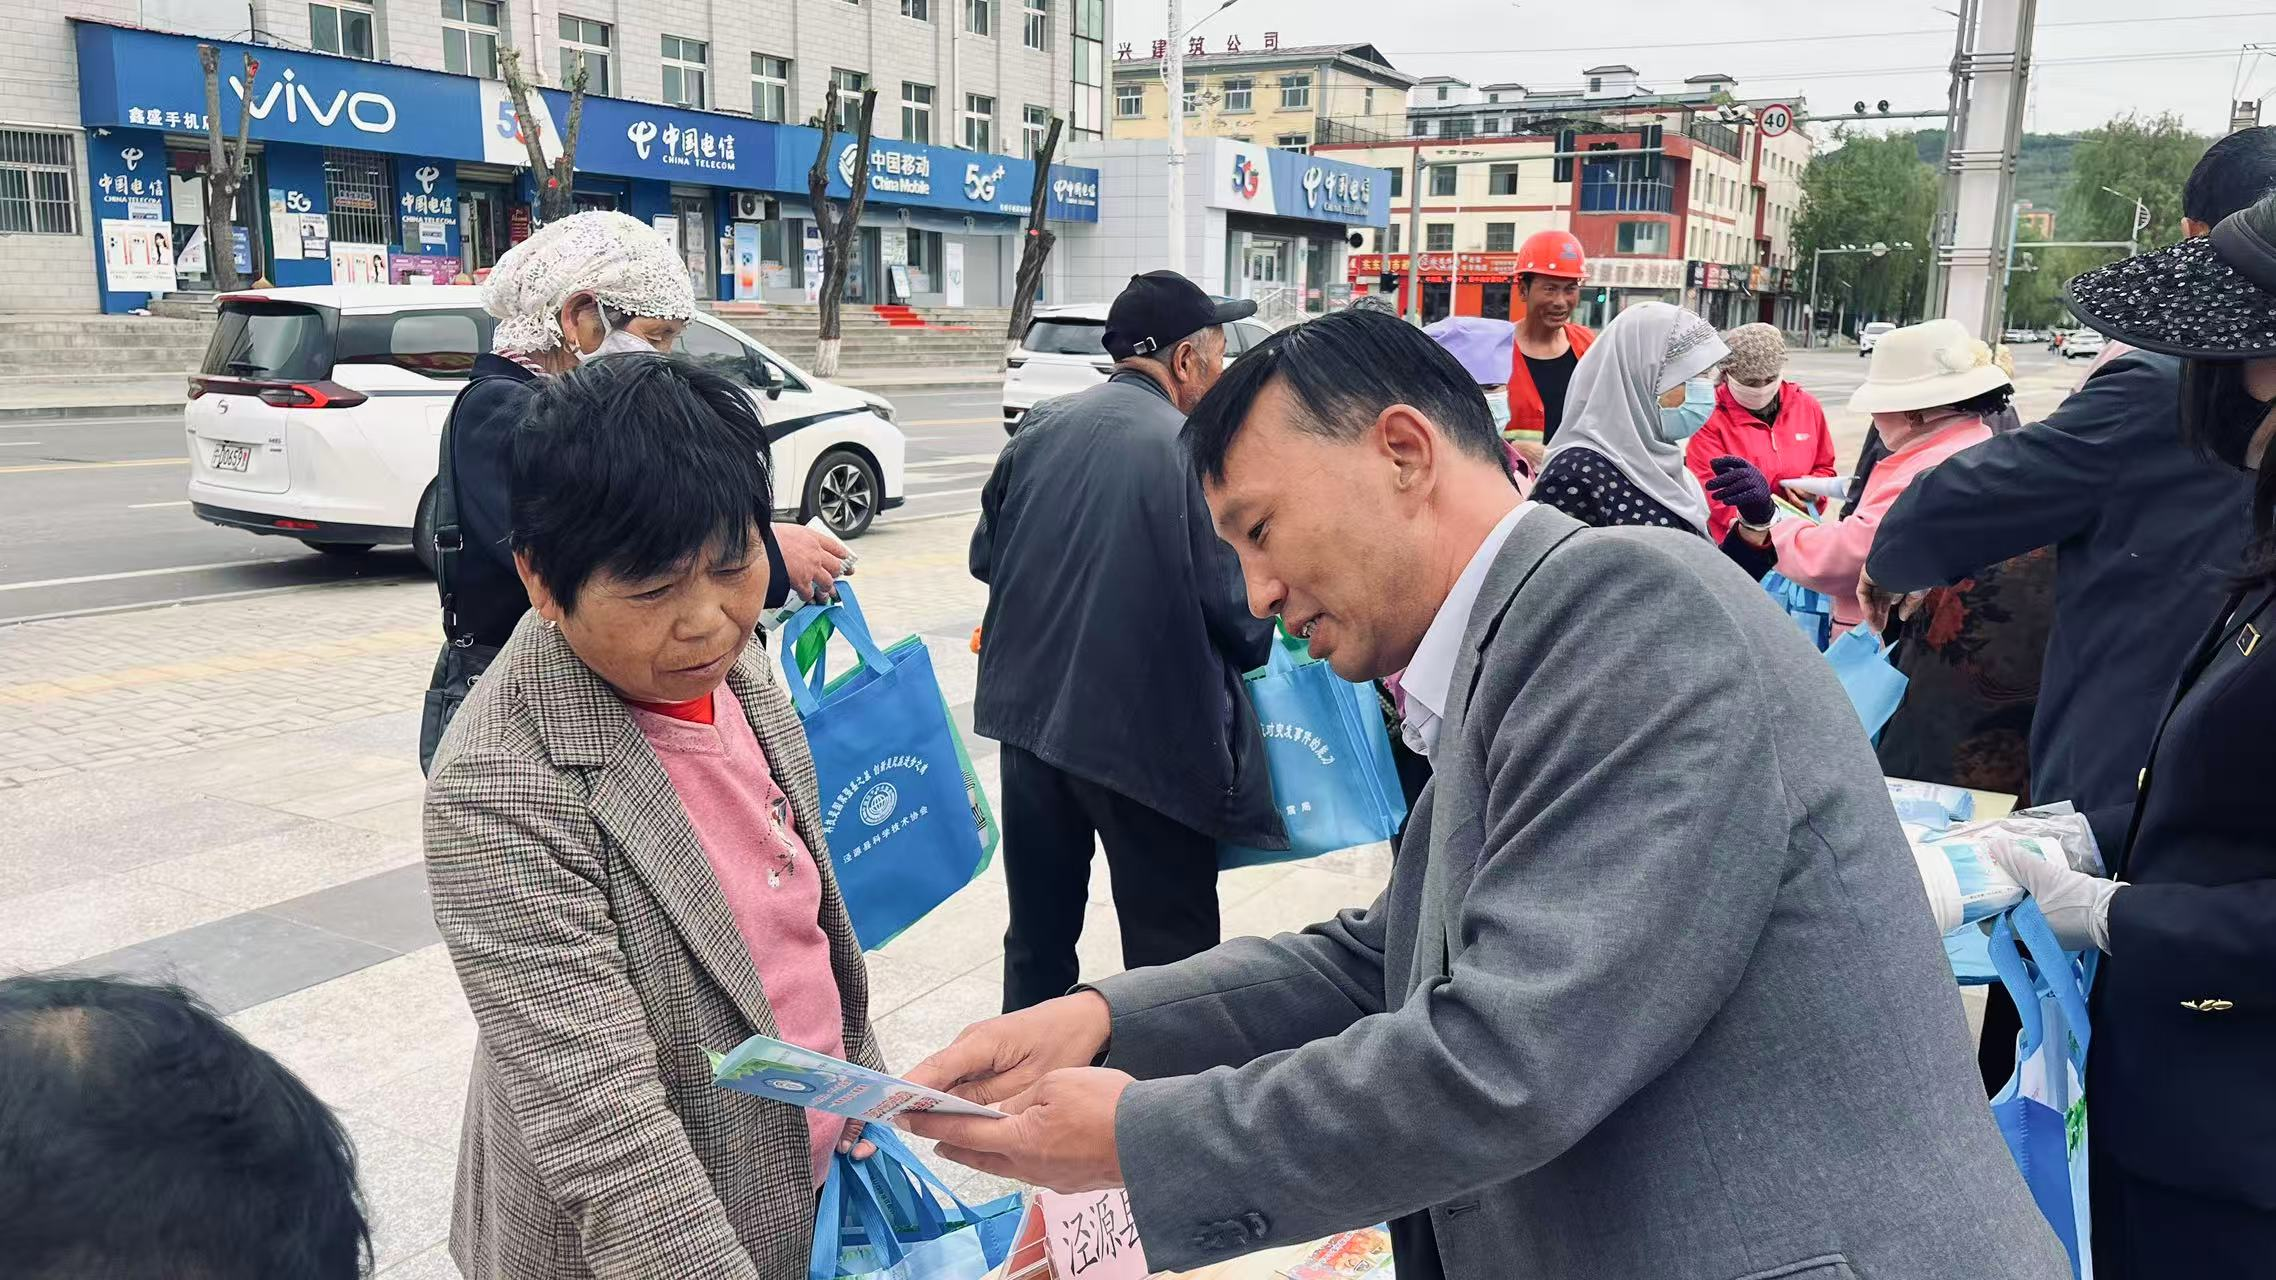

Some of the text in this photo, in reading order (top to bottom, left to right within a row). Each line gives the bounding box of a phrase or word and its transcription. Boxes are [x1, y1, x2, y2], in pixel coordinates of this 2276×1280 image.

[1117, 31, 1279, 61] 兴建筑公司
[228, 68, 397, 134] vivo
[1764, 113, 1786, 128] 40
[662, 122, 736, 161] 中国电信
[662, 155, 736, 172] CHINA TELECOM
[871, 149, 930, 178] 中国移动
[1231, 154, 1259, 200] 5G
[98, 172, 164, 197] 中国电信
[871, 175, 930, 196] China Mobile
[1324, 170, 1371, 204] 中国电信
[287, 190, 312, 213] 5G
[401, 191, 453, 215] 中国电信
[402, 215, 425, 224] CHINA
[843, 805, 928, 864] 泾源县科学技术协会
